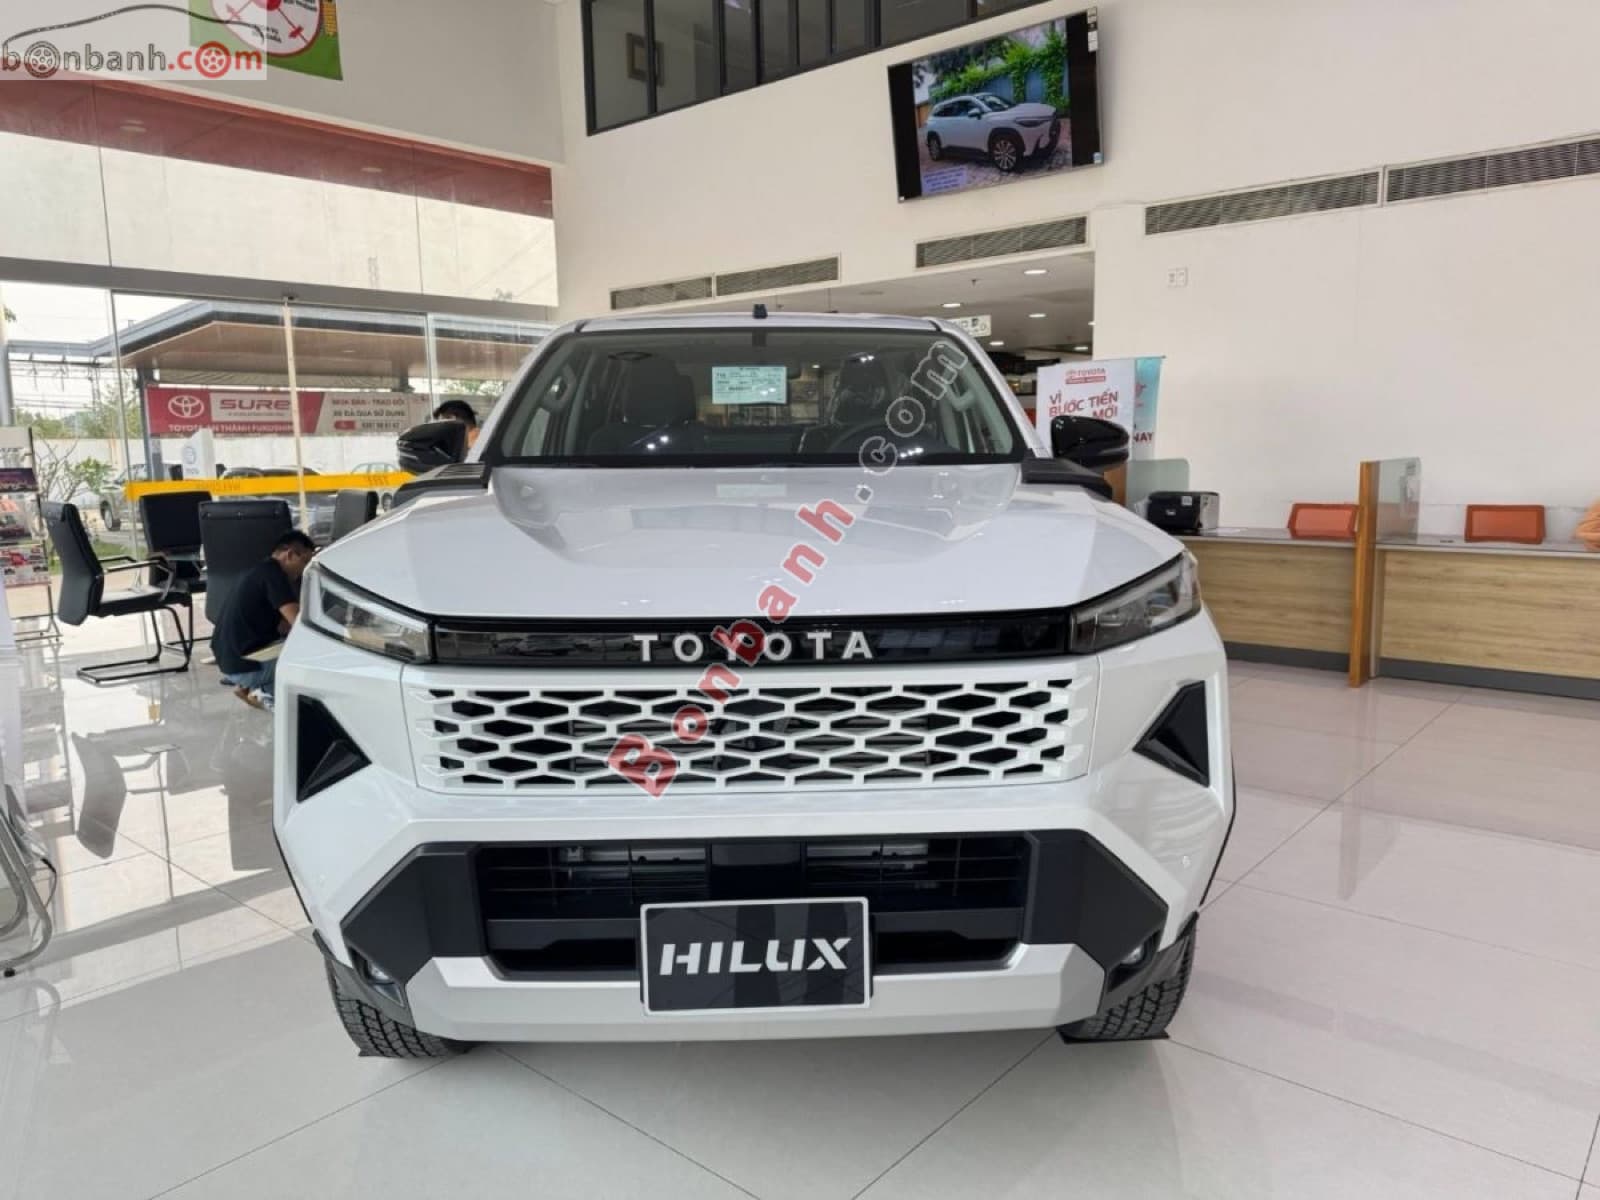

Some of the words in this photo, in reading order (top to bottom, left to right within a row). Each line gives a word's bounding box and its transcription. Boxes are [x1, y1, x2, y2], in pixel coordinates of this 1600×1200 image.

[220, 399, 290, 410] SURE
[632, 631, 874, 662] TOYOTA
[659, 937, 852, 976] HILUX
